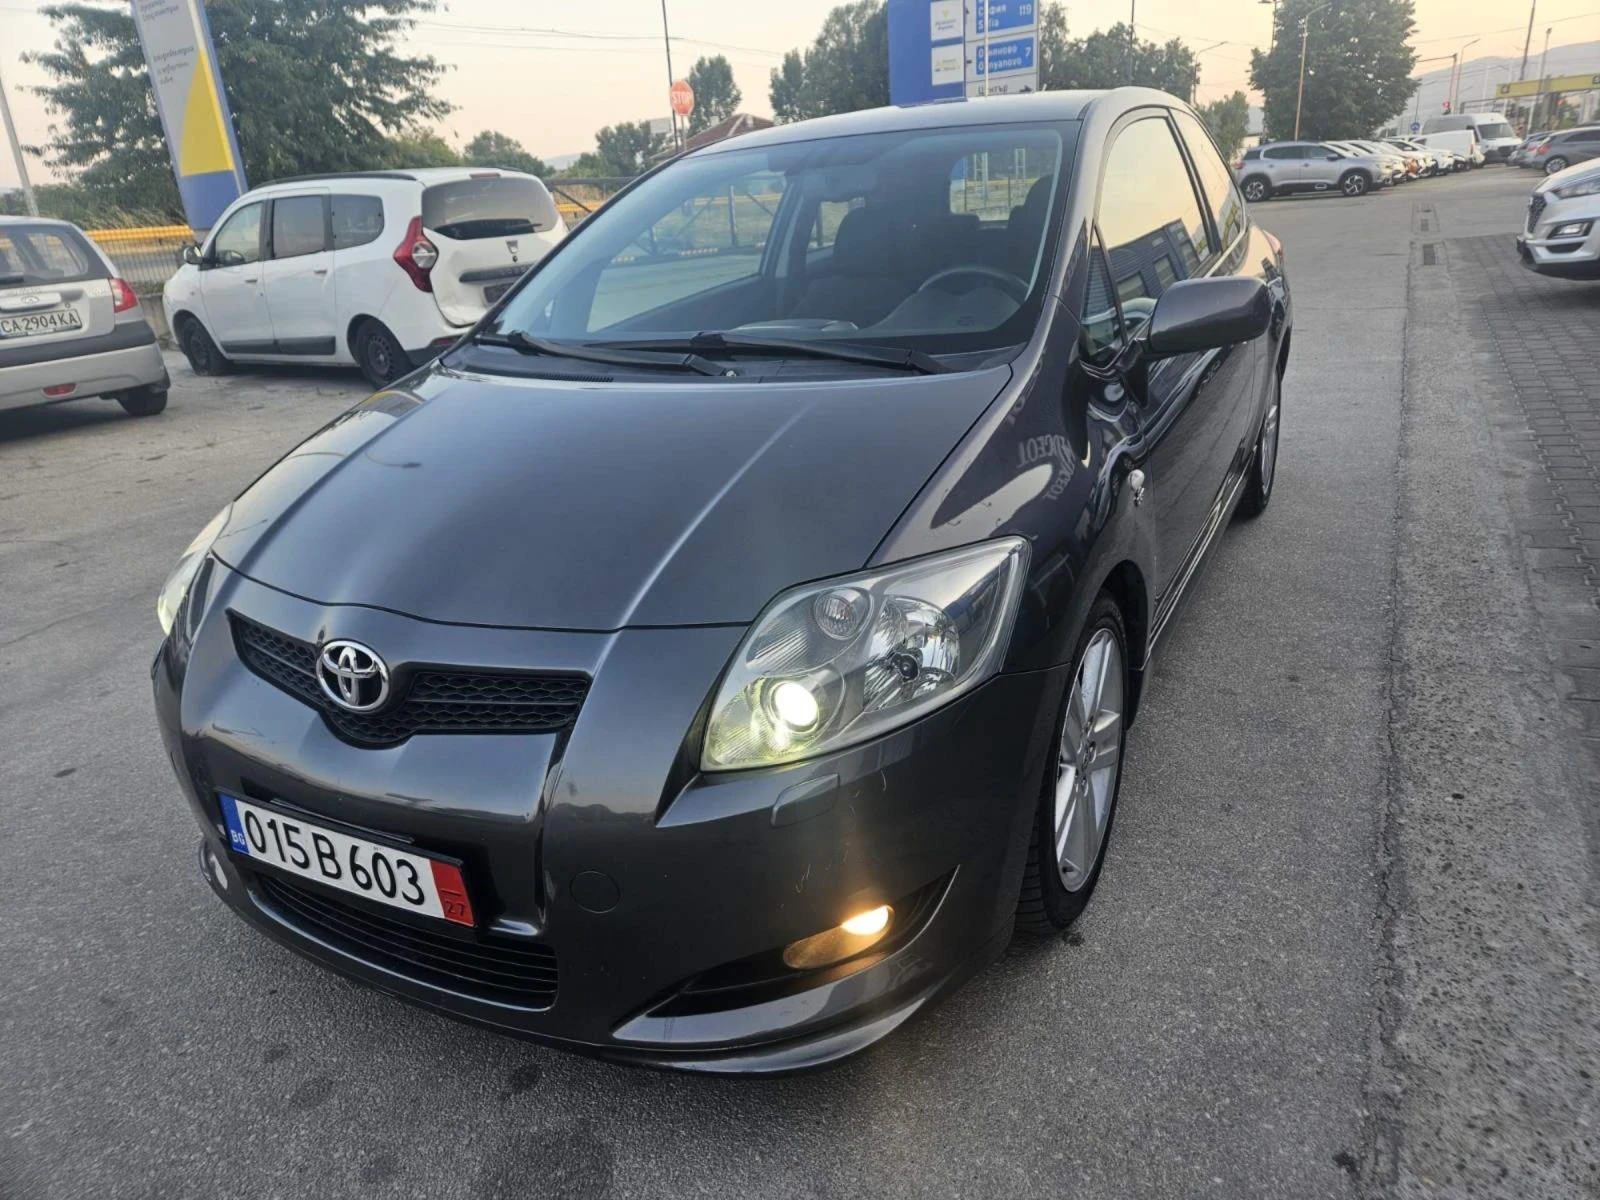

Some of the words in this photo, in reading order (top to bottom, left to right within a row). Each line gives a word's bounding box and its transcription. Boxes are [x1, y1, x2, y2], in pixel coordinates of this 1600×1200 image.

[978, 4, 1007, 17] Сфия
[1019, 4, 1032, 16] 119
[978, 18, 999, 30] Sfia
[1025, 47, 1031, 57] 7
[978, 58, 1022, 71] Onyanovo
[978, 84, 1008, 95] Цнтър
[671, 91, 692, 105] STOP
[231, 829, 246, 846] BG
